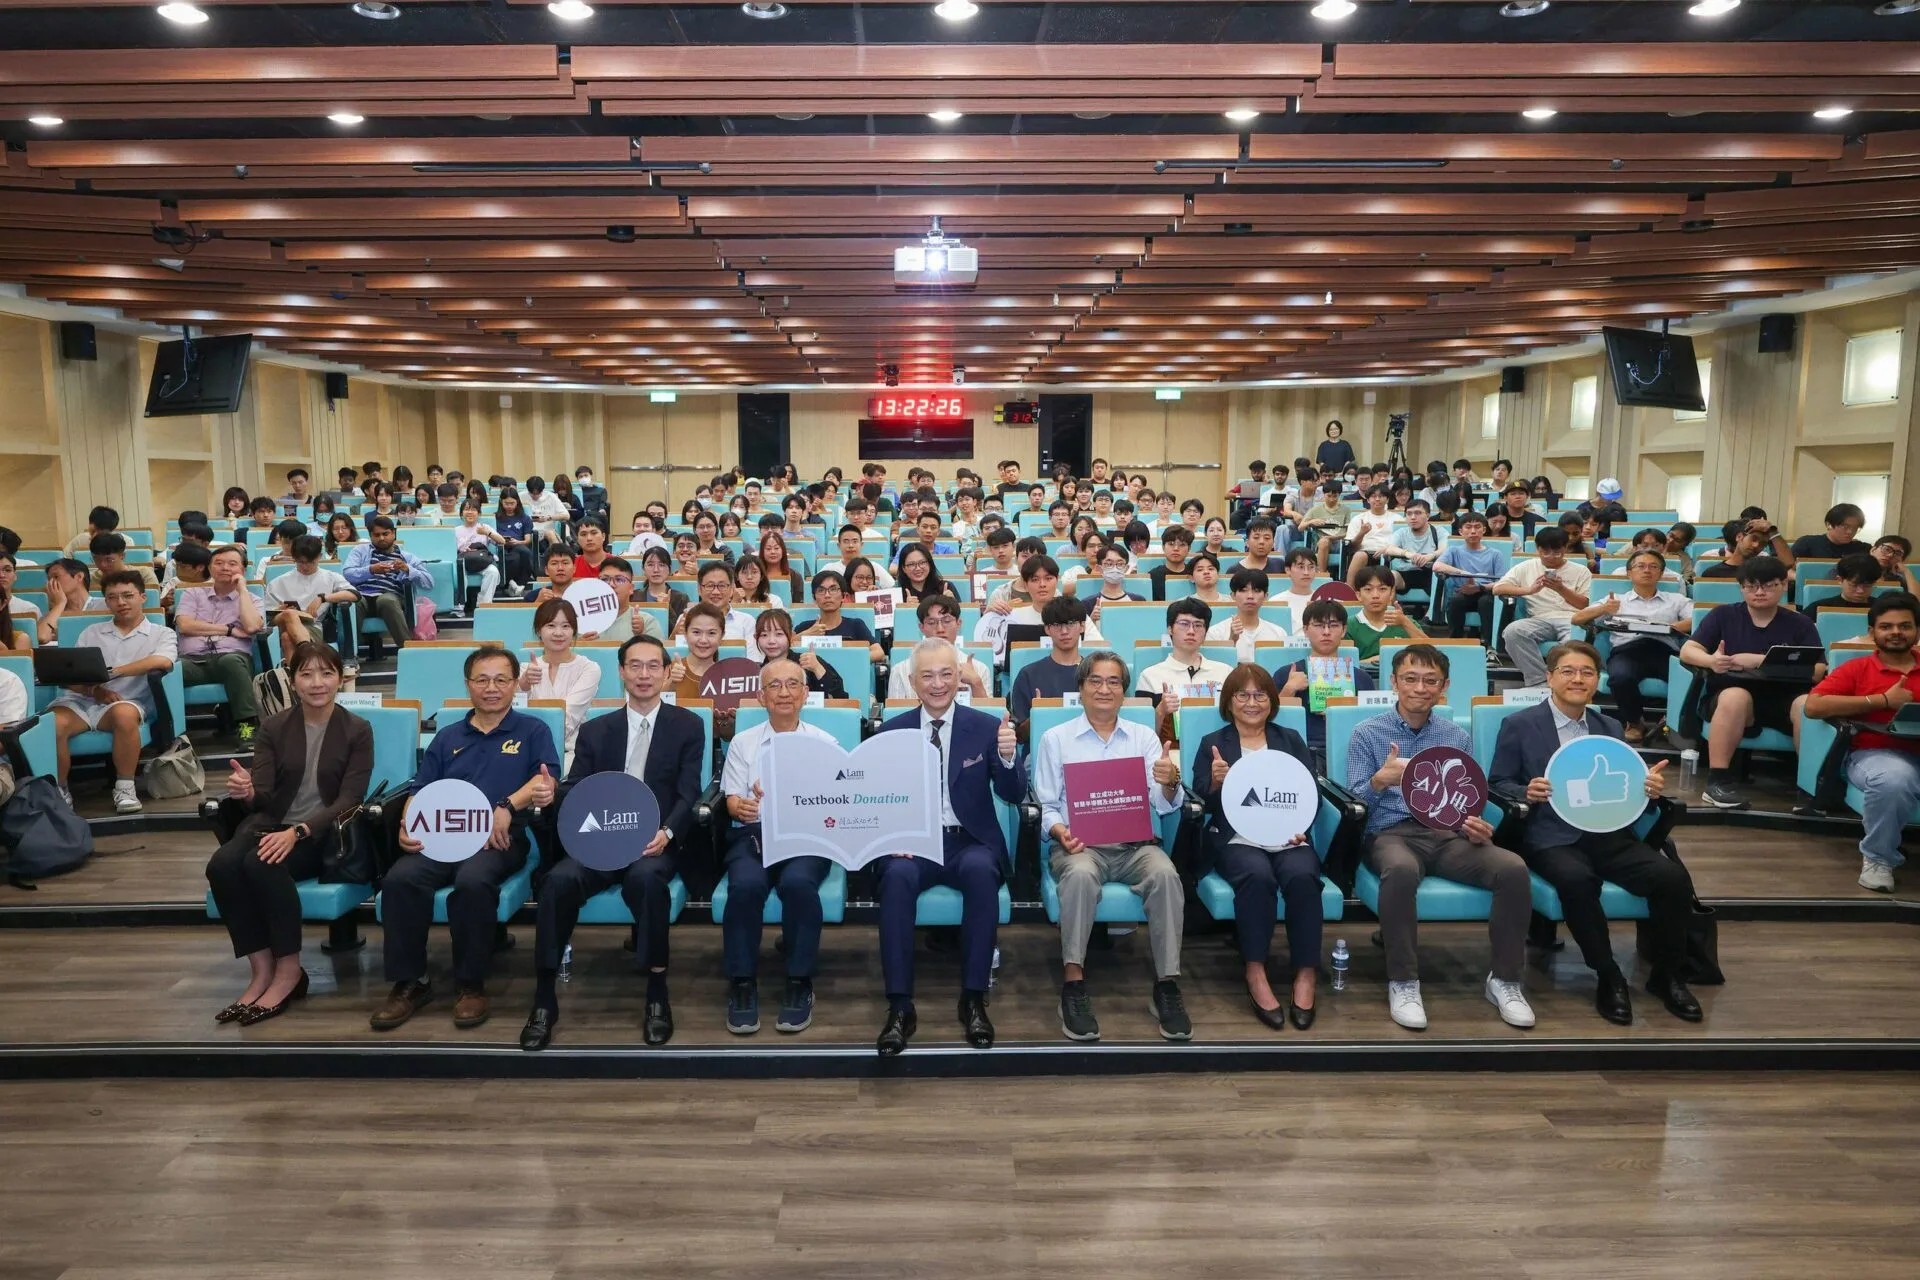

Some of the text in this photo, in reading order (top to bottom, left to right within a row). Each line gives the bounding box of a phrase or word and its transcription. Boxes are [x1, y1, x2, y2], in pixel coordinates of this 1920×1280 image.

[877, 399, 961, 416] 13:22:26
[579, 593, 617, 616] ISM
[501, 739, 522, 754] Cal
[846, 769, 865, 777] Lam
[792, 792, 909, 806] Textbook Donation
[1264, 787, 1297, 804] Lam
[1264, 803, 1297, 811] RESEARCH
[410, 809, 489, 833] AISM
[603, 809, 639, 825] Lam
[603, 823, 639, 832] RESEARCH
